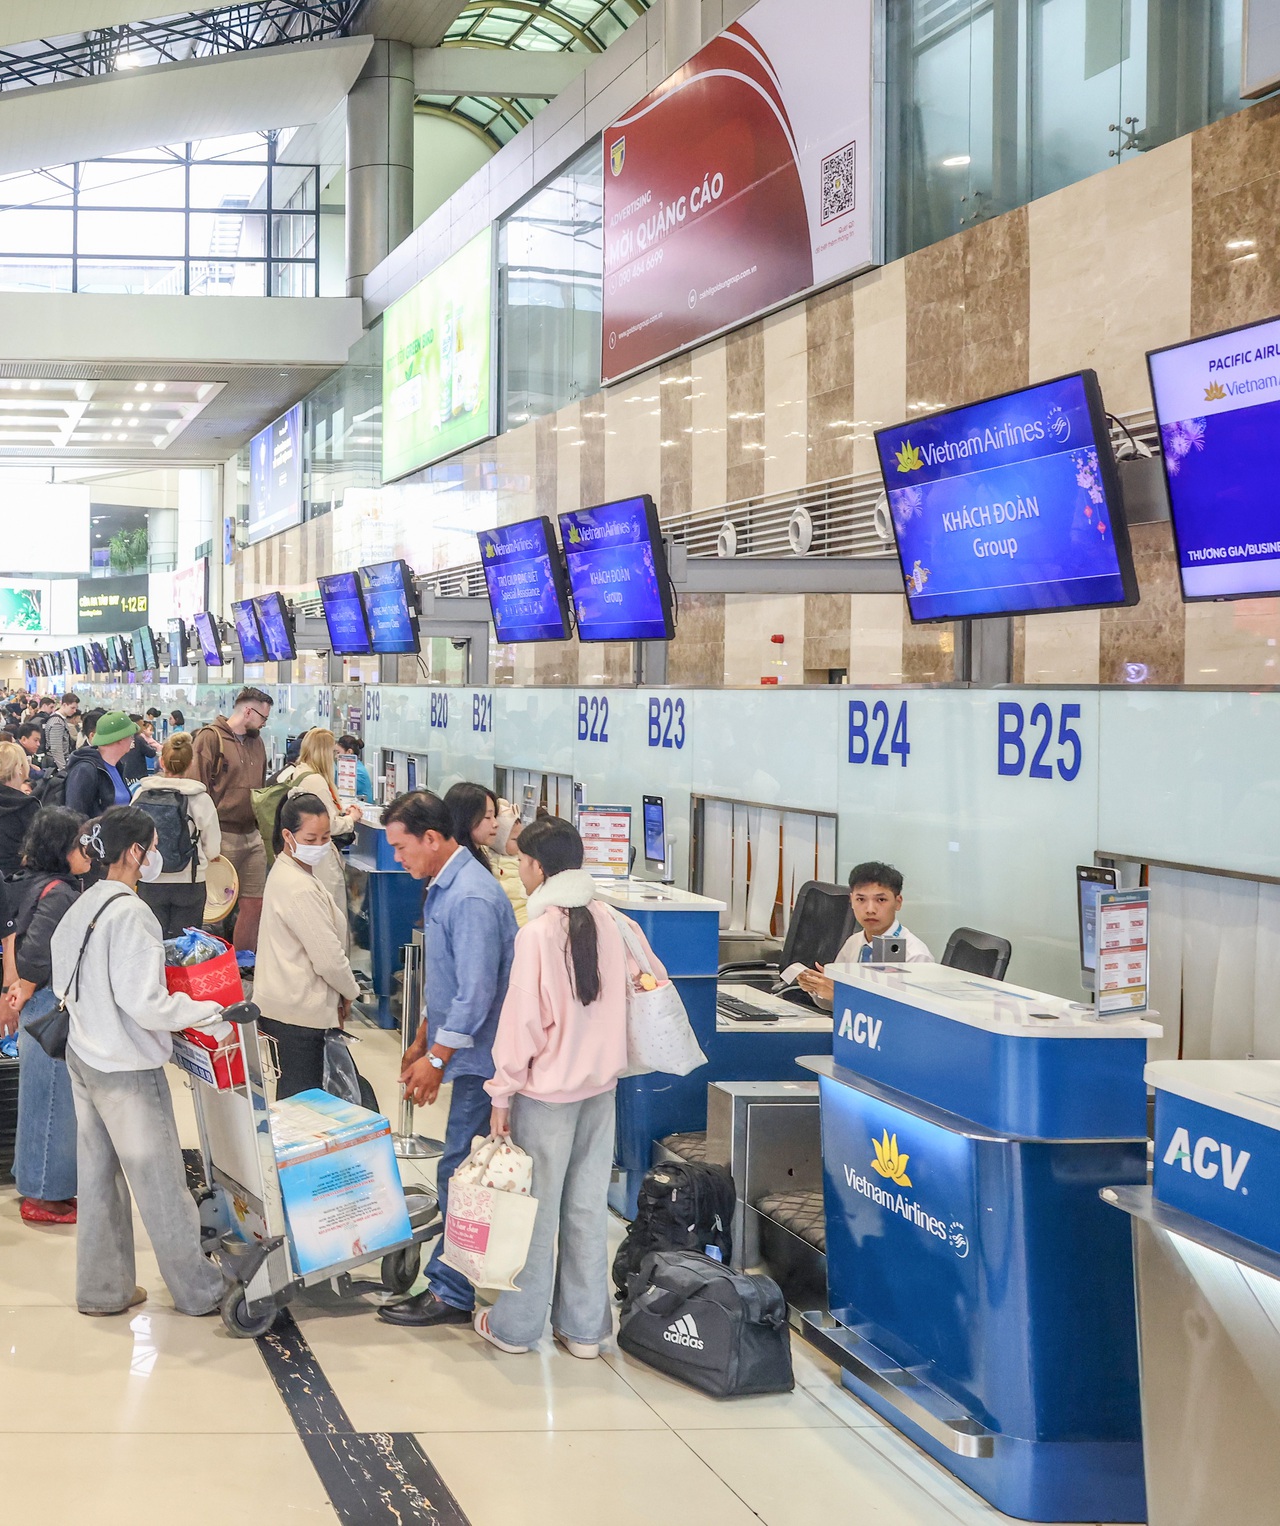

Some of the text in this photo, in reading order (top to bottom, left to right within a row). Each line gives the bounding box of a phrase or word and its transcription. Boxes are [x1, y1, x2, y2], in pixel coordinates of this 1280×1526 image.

[609, 190, 651, 228] ADVERTISING
[636, 196, 686, 249] QUẢNG
[689, 172, 724, 214] CÁO
[645, 248, 664, 271] 6699
[1208, 350, 1252, 373] PACIFIC
[1225, 375, 1277, 396] Vietnam
[920, 438, 984, 466] Vietnam
[984, 420, 1045, 452] Airlines
[578, 520, 631, 541] Vietnam Airlines
[942, 494, 1040, 533] KHÁCH ĐOÀN
[492, 537, 533, 556] Vietnam Airlines
[973, 537, 1018, 559] Group
[121, 597, 137, 612] 1-12
[501, 587, 518, 602] Special
[603, 590, 623, 606] Group
[366, 691, 380, 722] B19
[430, 692, 448, 728] B20
[473, 693, 493, 732] B21
[577, 696, 609, 743] B22
[648, 697, 685, 749] B23
[848, 700, 910, 767] B24
[997, 702, 1082, 782] B25
[838, 1008, 883, 1050] ACV
[1163, 1126, 1251, 1191] ACV
[843, 1163, 896, 1213] Vietnam
[894, 1193, 947, 1240] Airlines
[663, 1331, 704, 1350] adidas
